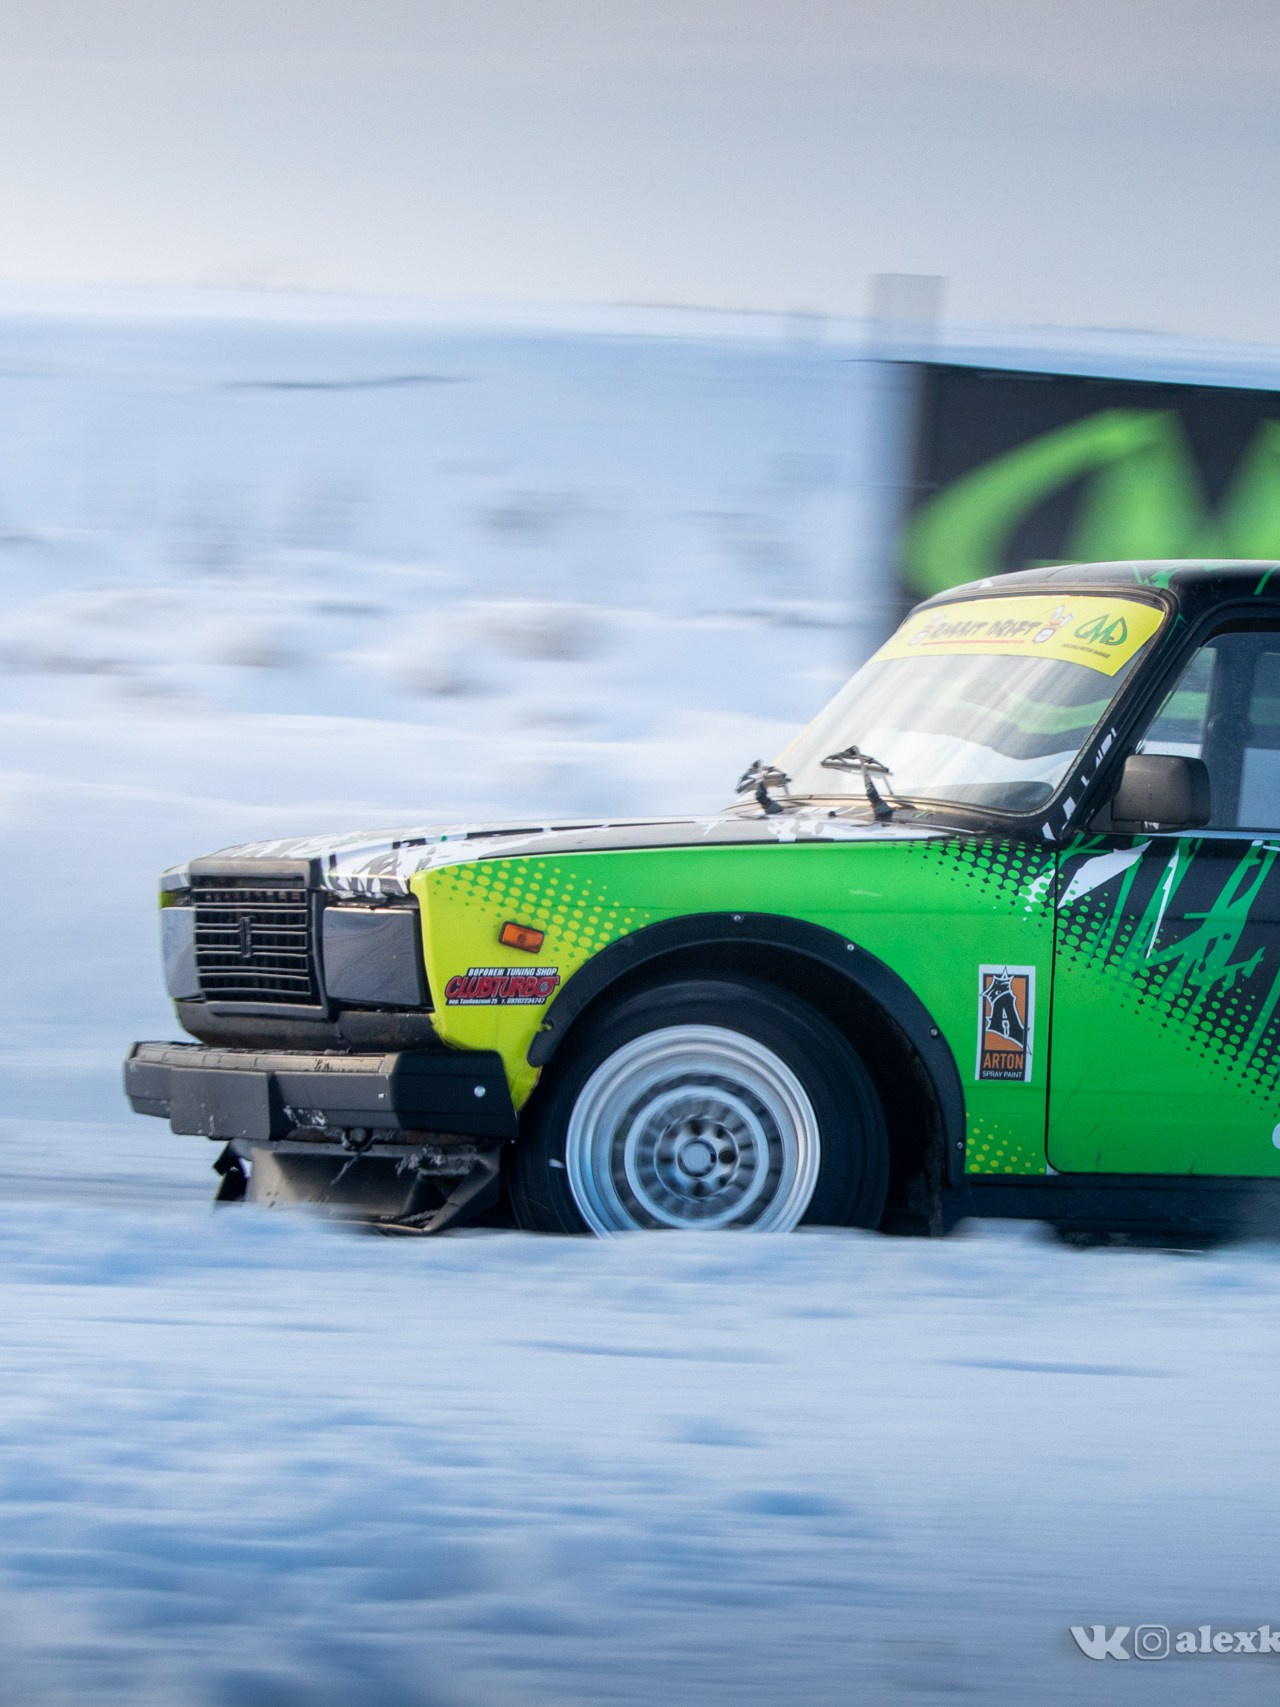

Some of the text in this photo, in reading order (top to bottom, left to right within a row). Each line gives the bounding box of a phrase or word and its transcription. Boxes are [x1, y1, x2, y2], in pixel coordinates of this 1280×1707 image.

[506, 968, 535, 976] TUNING
[536, 968, 557, 976] SHOP
[445, 976, 560, 998] CLUBTURBO
[983, 1053, 1024, 1070] ARTON
